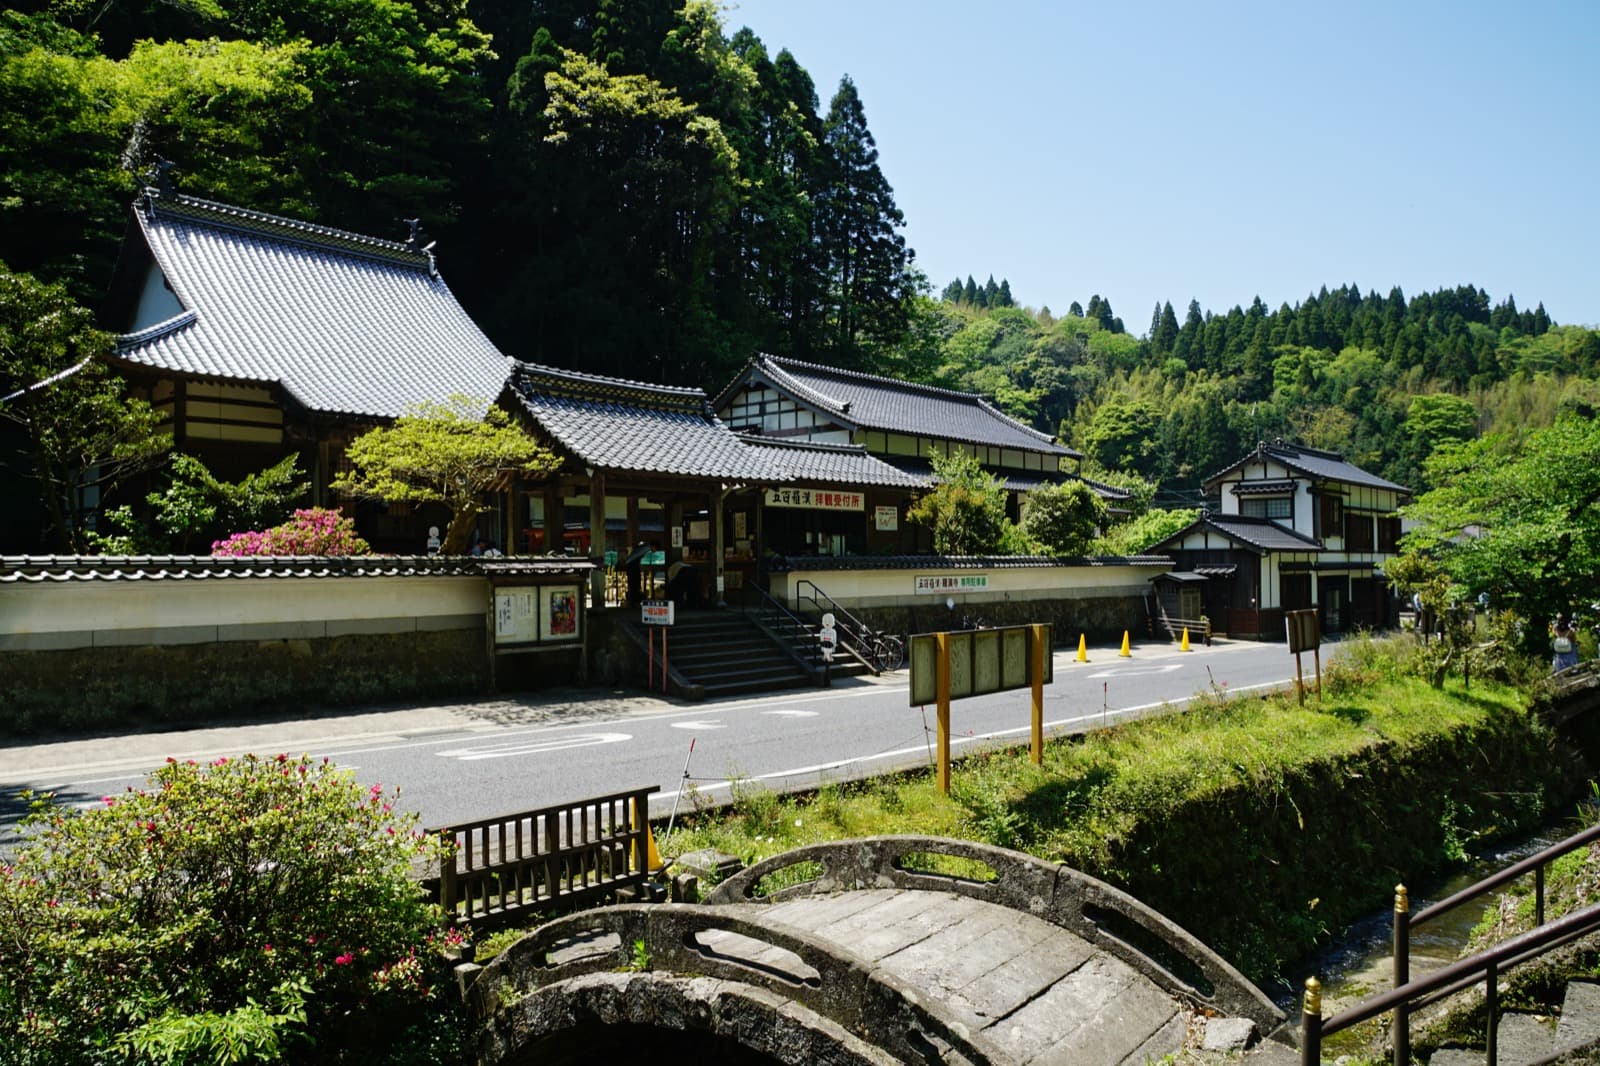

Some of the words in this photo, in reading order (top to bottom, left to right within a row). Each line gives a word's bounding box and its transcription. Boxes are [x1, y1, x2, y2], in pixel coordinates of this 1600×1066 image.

[815, 492, 860, 508] 拝観受付所
